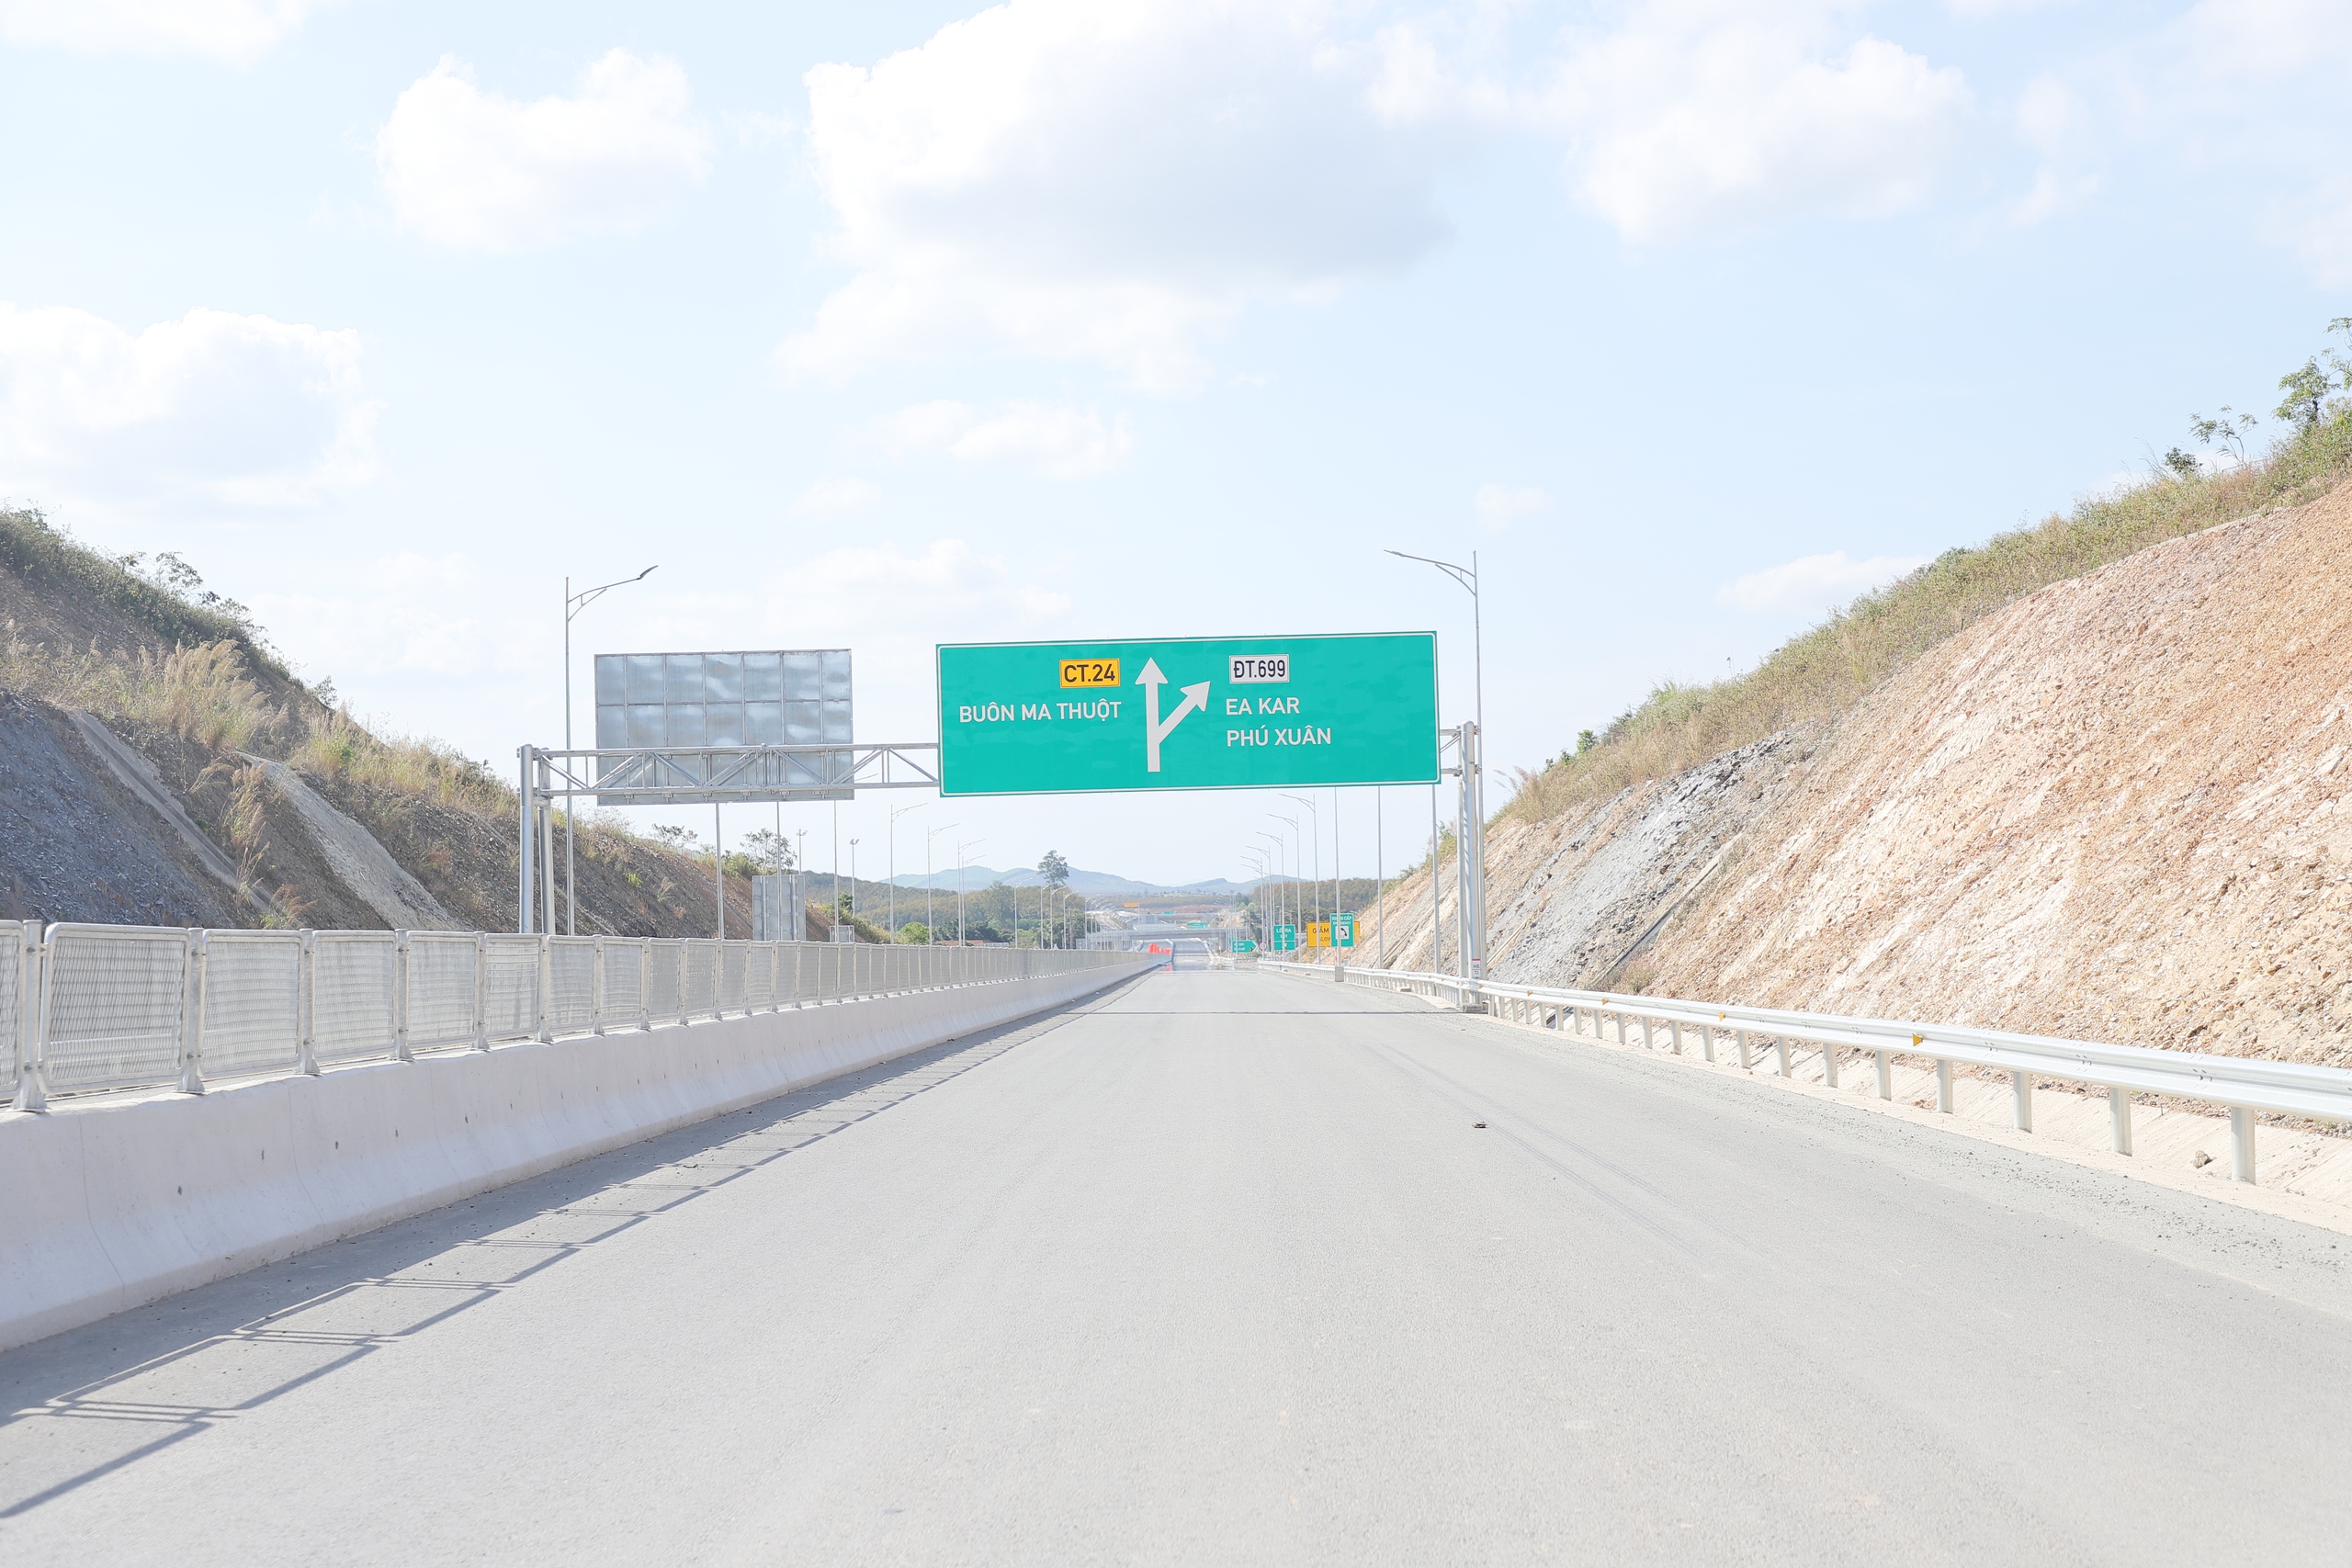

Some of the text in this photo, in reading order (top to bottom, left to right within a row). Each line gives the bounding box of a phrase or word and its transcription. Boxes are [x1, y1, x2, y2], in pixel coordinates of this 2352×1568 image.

[1064, 663, 1115, 682] CT.24
[1233, 660, 1285, 678] ĐT.699
[959, 698, 1122, 723] BUÔN MA THUỘT
[1226, 696, 1300, 716] EA KAR
[1227, 724, 1331, 747] PHÚ XUÂN
[1312, 925, 1329, 934] GẢM
